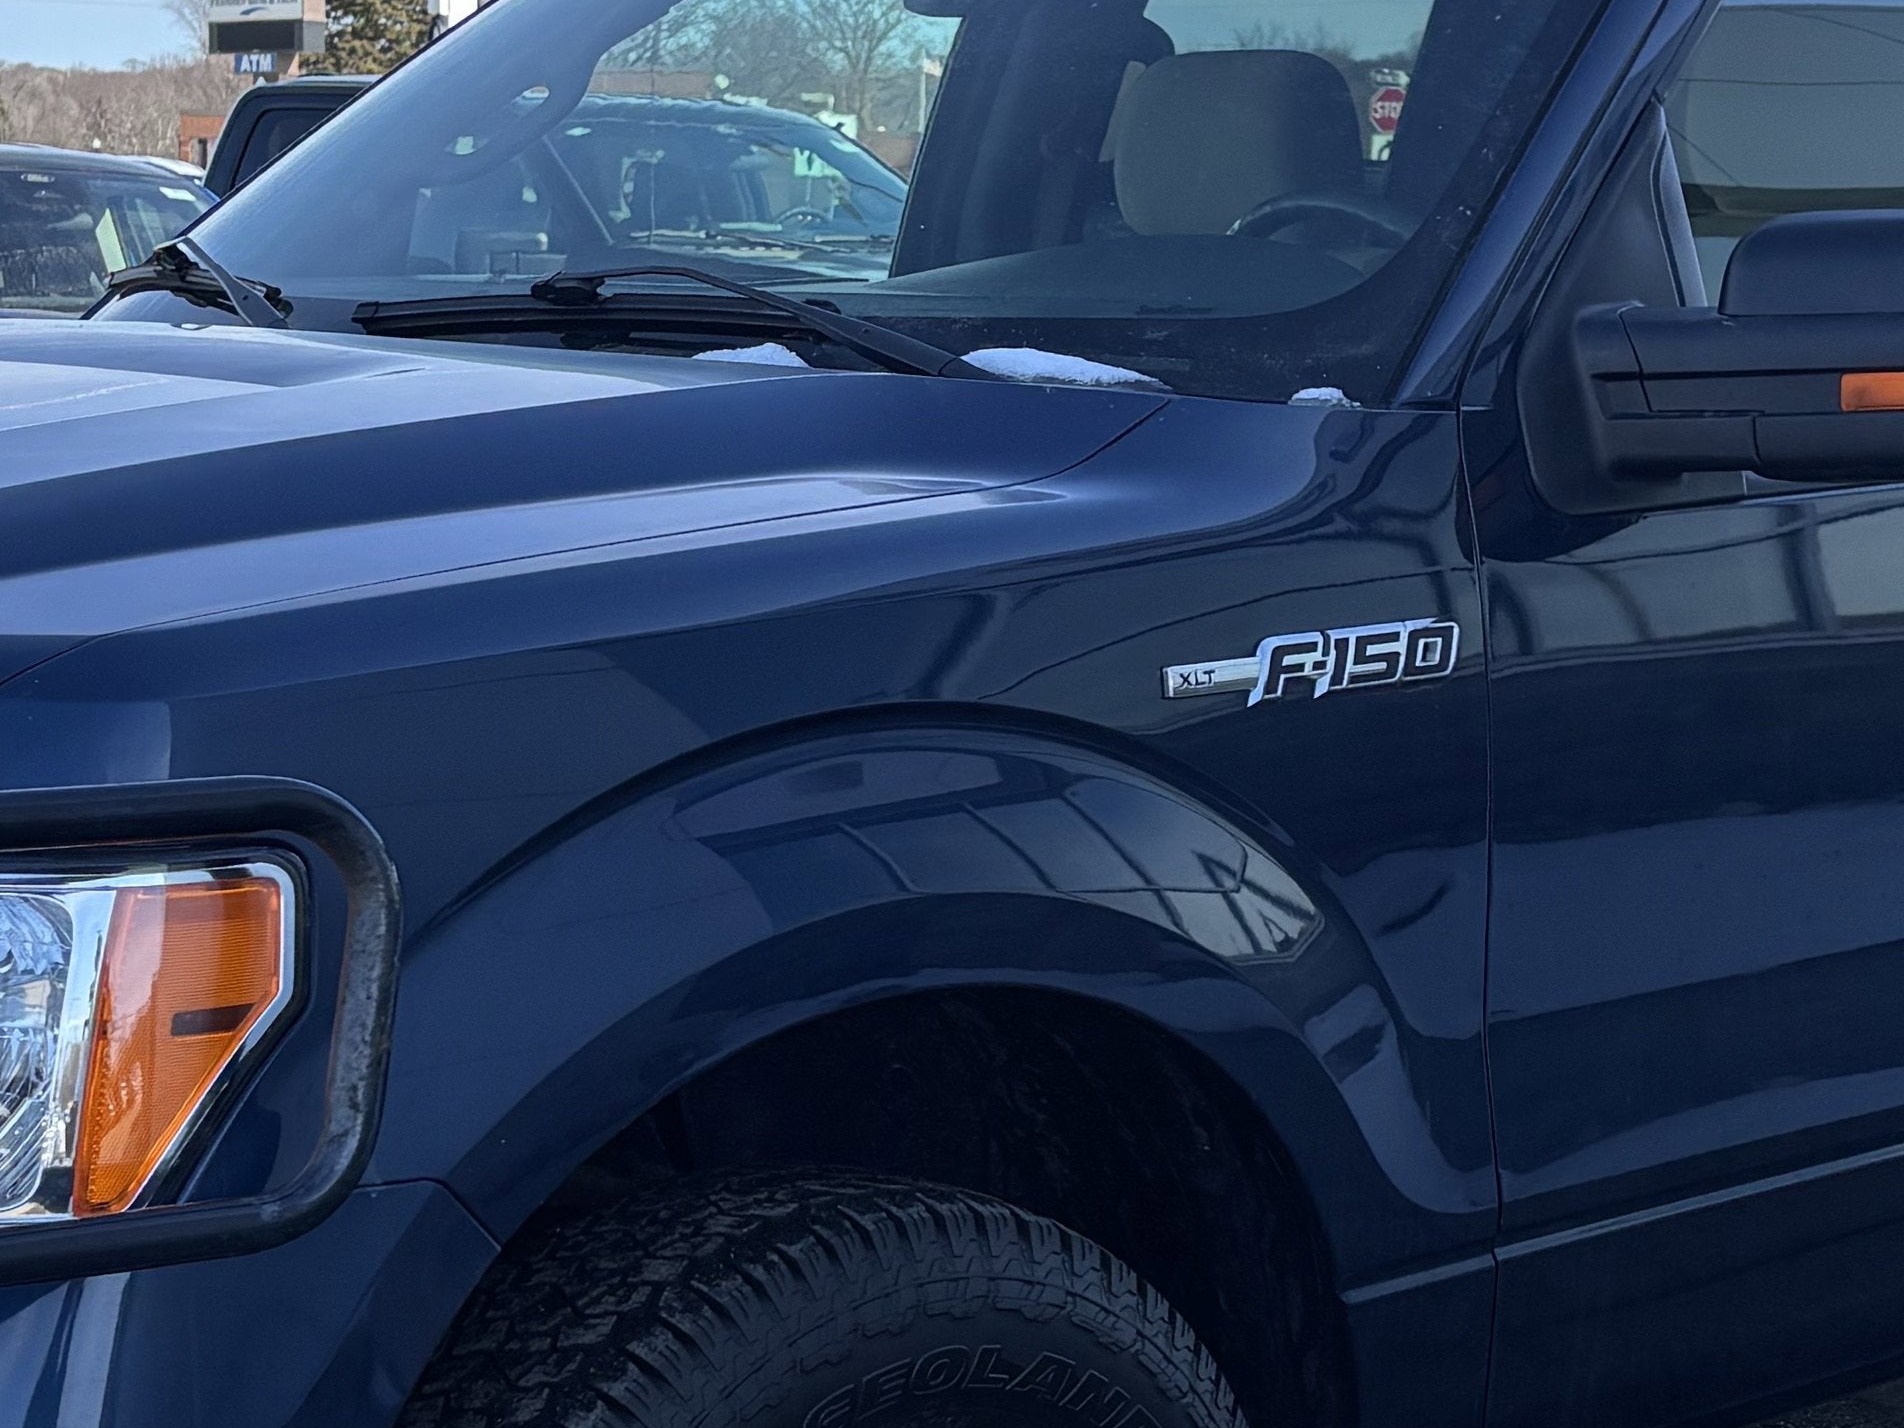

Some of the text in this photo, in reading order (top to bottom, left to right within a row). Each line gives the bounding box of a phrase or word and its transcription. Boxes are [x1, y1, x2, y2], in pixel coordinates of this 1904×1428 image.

[239, 53, 273, 72] ATM
[1372, 102, 1403, 119] STO
[1178, 669, 1217, 689] XLT
